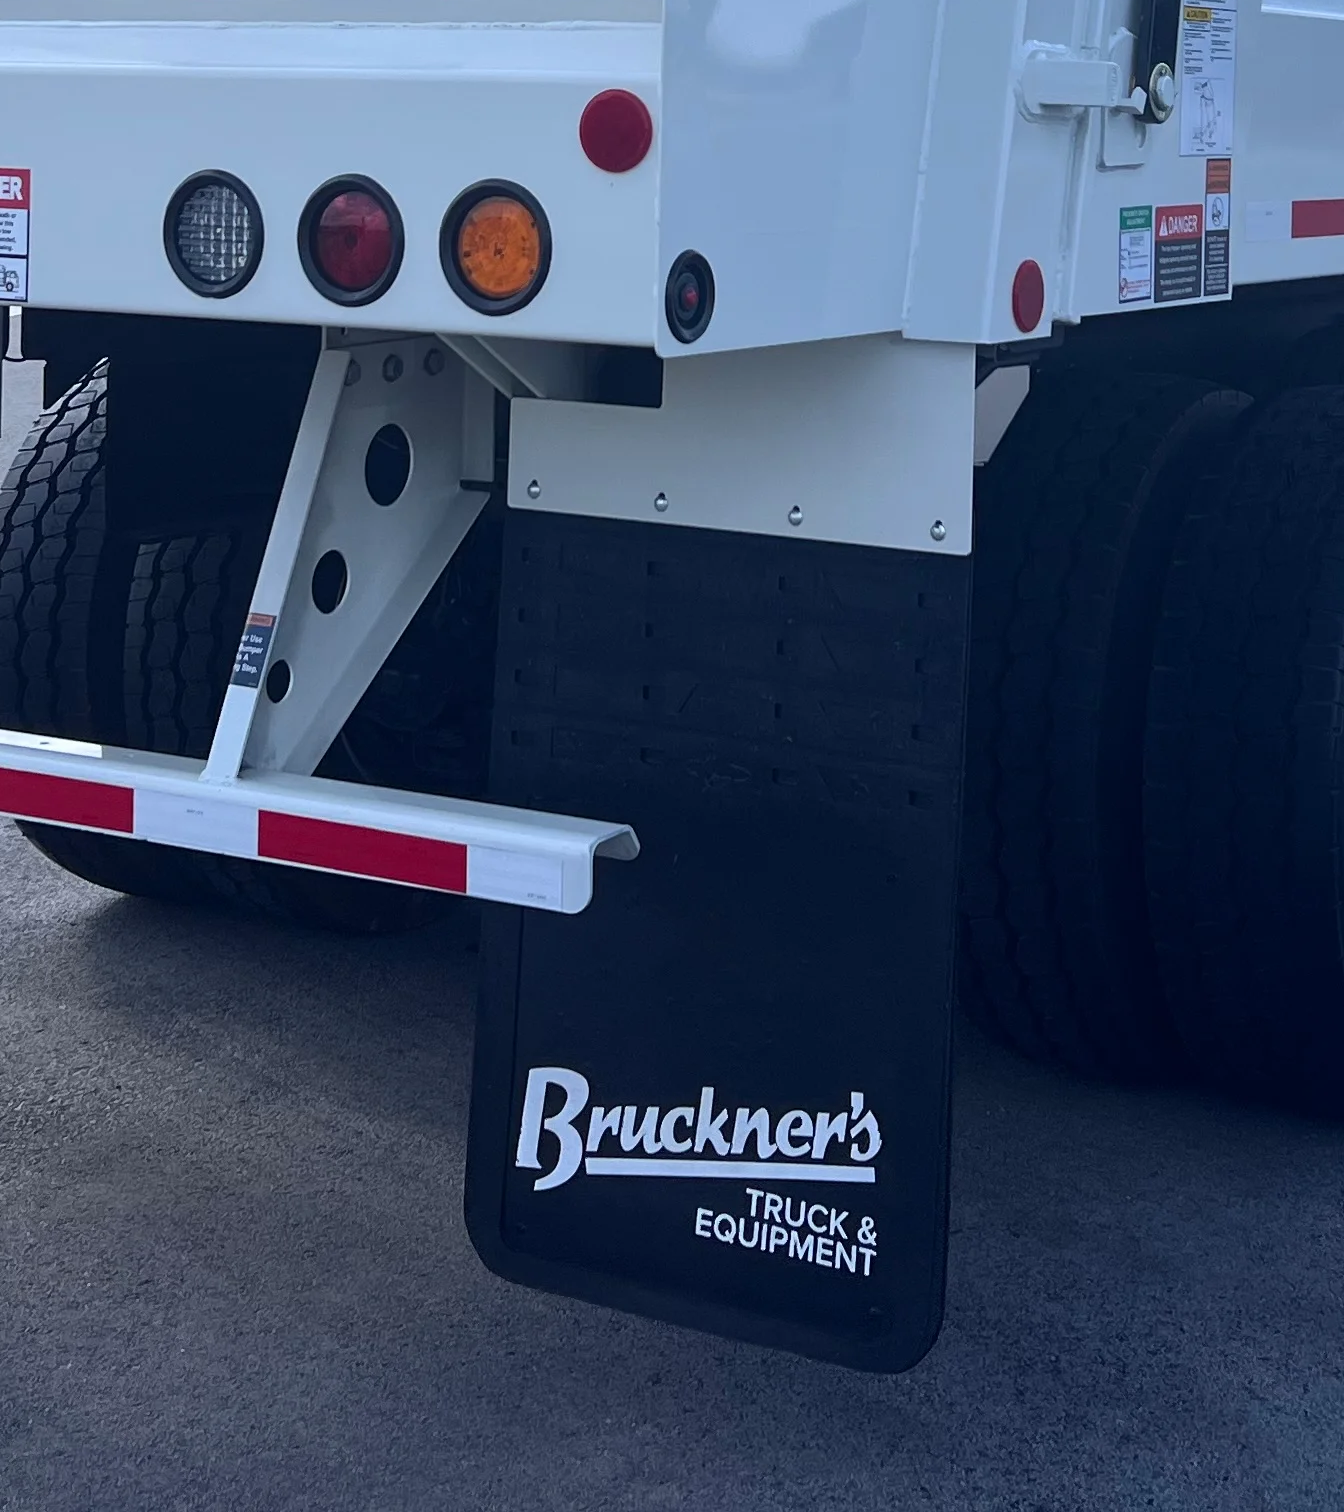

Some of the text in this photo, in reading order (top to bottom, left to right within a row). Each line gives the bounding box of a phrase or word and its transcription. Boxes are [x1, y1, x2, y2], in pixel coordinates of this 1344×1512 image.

[1168, 215, 1198, 235] DANGER
[515, 1067, 882, 1191] Bruckner's
[695, 1207, 877, 1276] EQUIPMENT
[746, 1187, 878, 1246] TRUCK &
